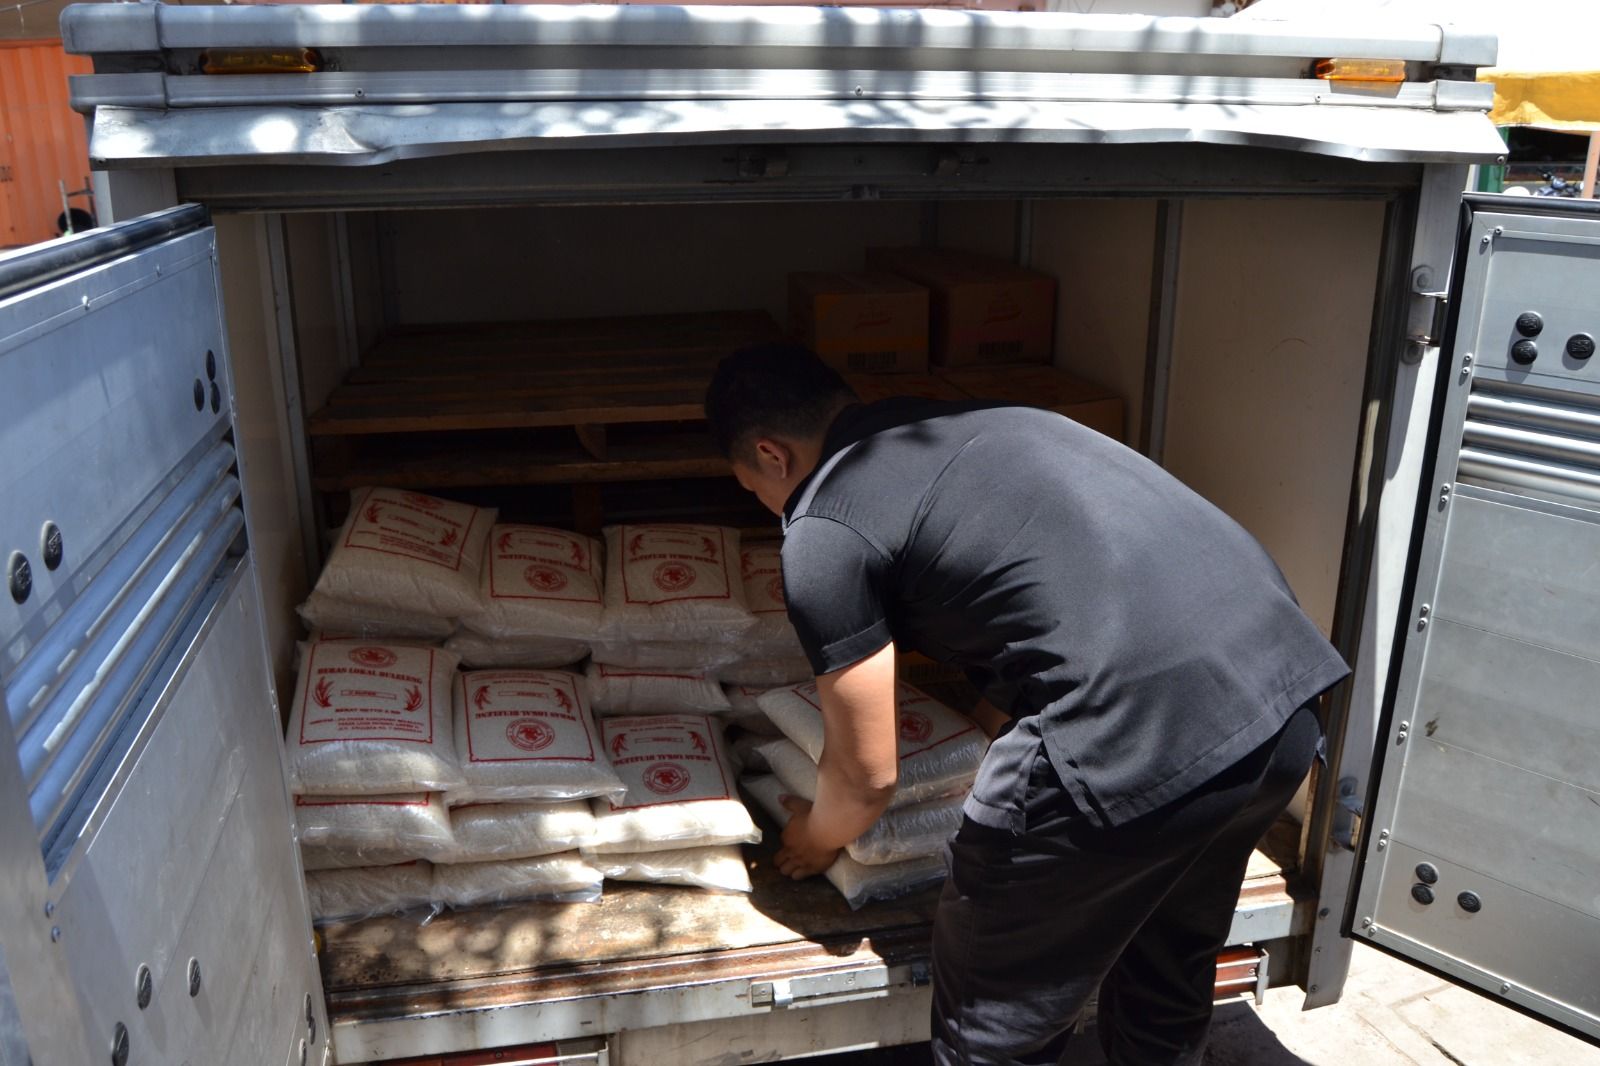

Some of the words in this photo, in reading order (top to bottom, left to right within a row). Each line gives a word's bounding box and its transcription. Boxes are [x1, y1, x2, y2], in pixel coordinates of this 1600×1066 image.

[348, 668, 377, 676] LOKAL
[379, 672, 423, 684] BULELENG
[475, 710, 520, 719] BULELENG
[521, 710, 548, 718] LOKAL
[612, 755, 655, 767] BULELENG
